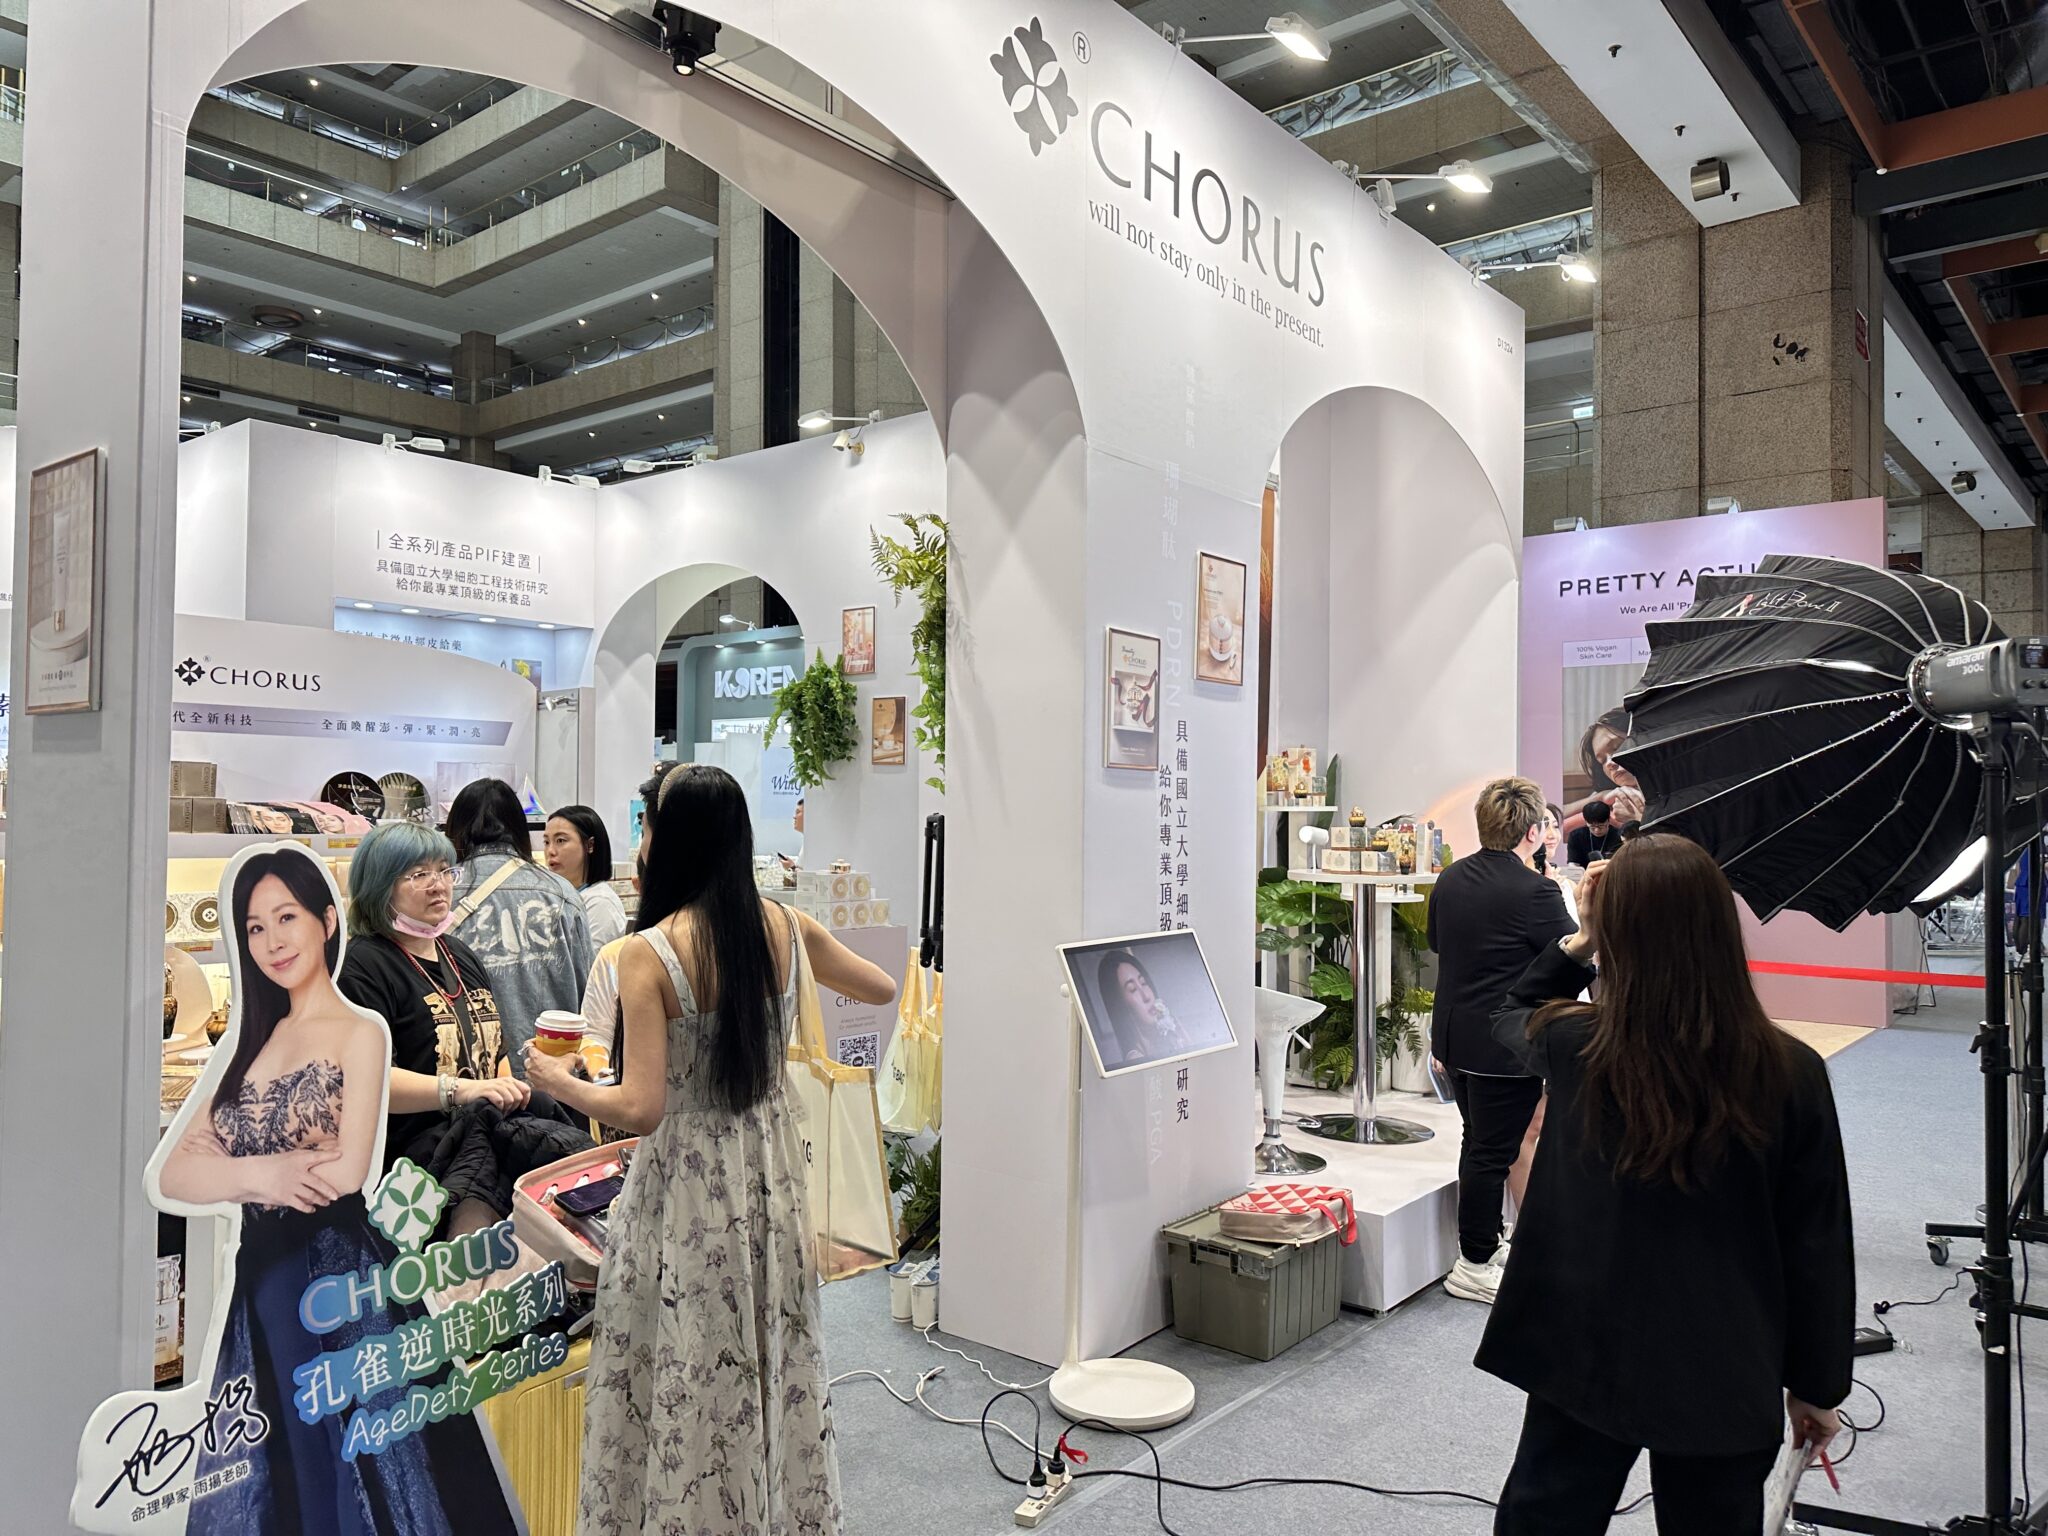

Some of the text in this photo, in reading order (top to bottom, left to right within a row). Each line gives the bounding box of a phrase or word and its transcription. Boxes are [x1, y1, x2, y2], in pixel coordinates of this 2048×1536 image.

[1091, 101, 1325, 307] CHORUS
[1089, 200, 1325, 348] will not stay only in the present.
[1497, 338, 1513, 354] D1324
[389, 532, 531, 569] 全系列產品PIF建置
[376, 559, 549, 595] 具備國立大學細胞工程技術研究
[396, 577, 531, 606] 給你最專業頂級的保養品
[1559, 571, 1666, 597] PRETTY
[1620, 606, 1636, 615] We
[1639, 604, 1657, 613] Are
[1660, 602, 1675, 612] All
[1164, 599, 1183, 708] PDRN
[1596, 645, 1617, 653] Vegan
[1946, 652, 1985, 667] amaran
[210, 666, 321, 692] CHORUS
[1962, 663, 1985, 675] 300c
[173, 710, 252, 726] 代全新科技
[304, 1224, 519, 1328] CHORUS
[301, 1266, 566, 1416] 孔雀逆時光系列
[349, 1339, 566, 1453] AgeDefy Series
[131, 1486, 190, 1523] 命理學家
